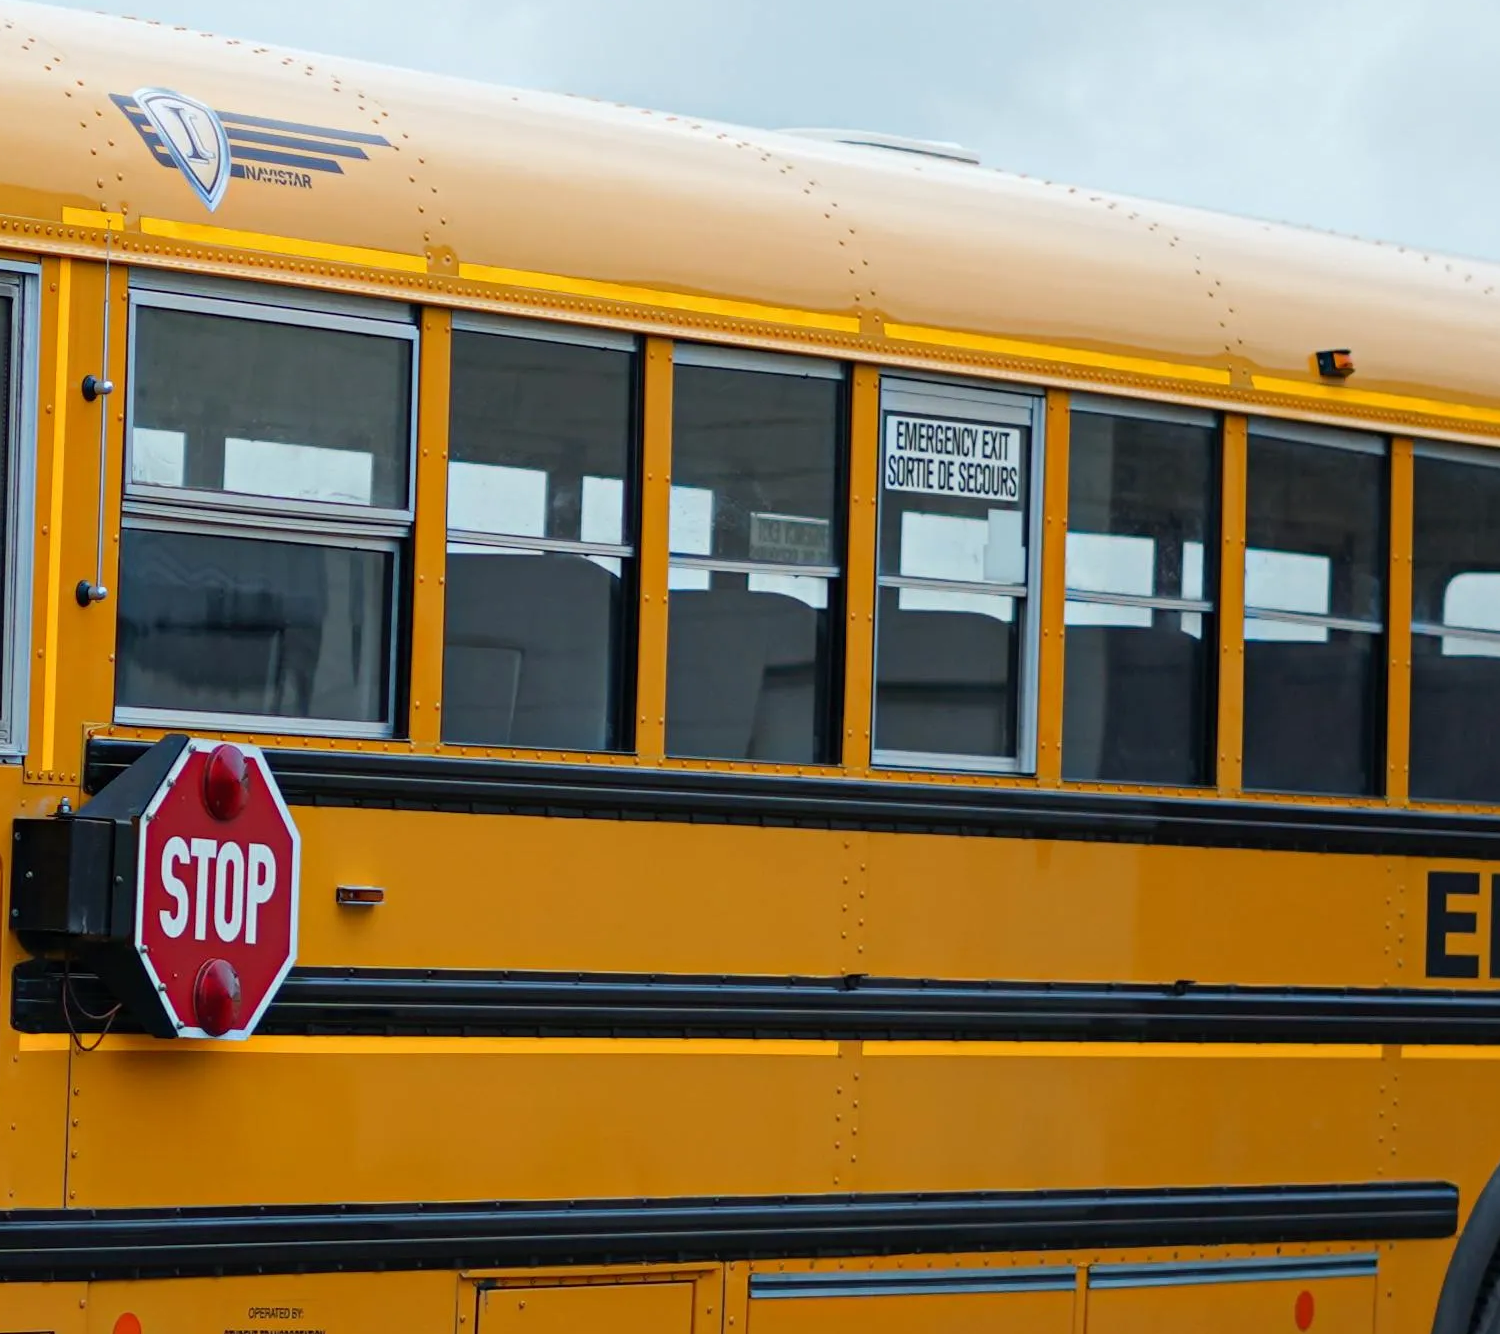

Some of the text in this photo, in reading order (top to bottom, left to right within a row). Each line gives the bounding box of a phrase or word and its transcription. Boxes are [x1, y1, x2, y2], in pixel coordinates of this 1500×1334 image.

[245, 164, 313, 189] NAVISTAR
[896, 420, 1010, 462] EMERGENCY EXIT
[888, 454, 1018, 498] SORTIE DE SECOURS
[159, 836, 277, 945] STOP
[248, 1307, 290, 1319] OPERATED
